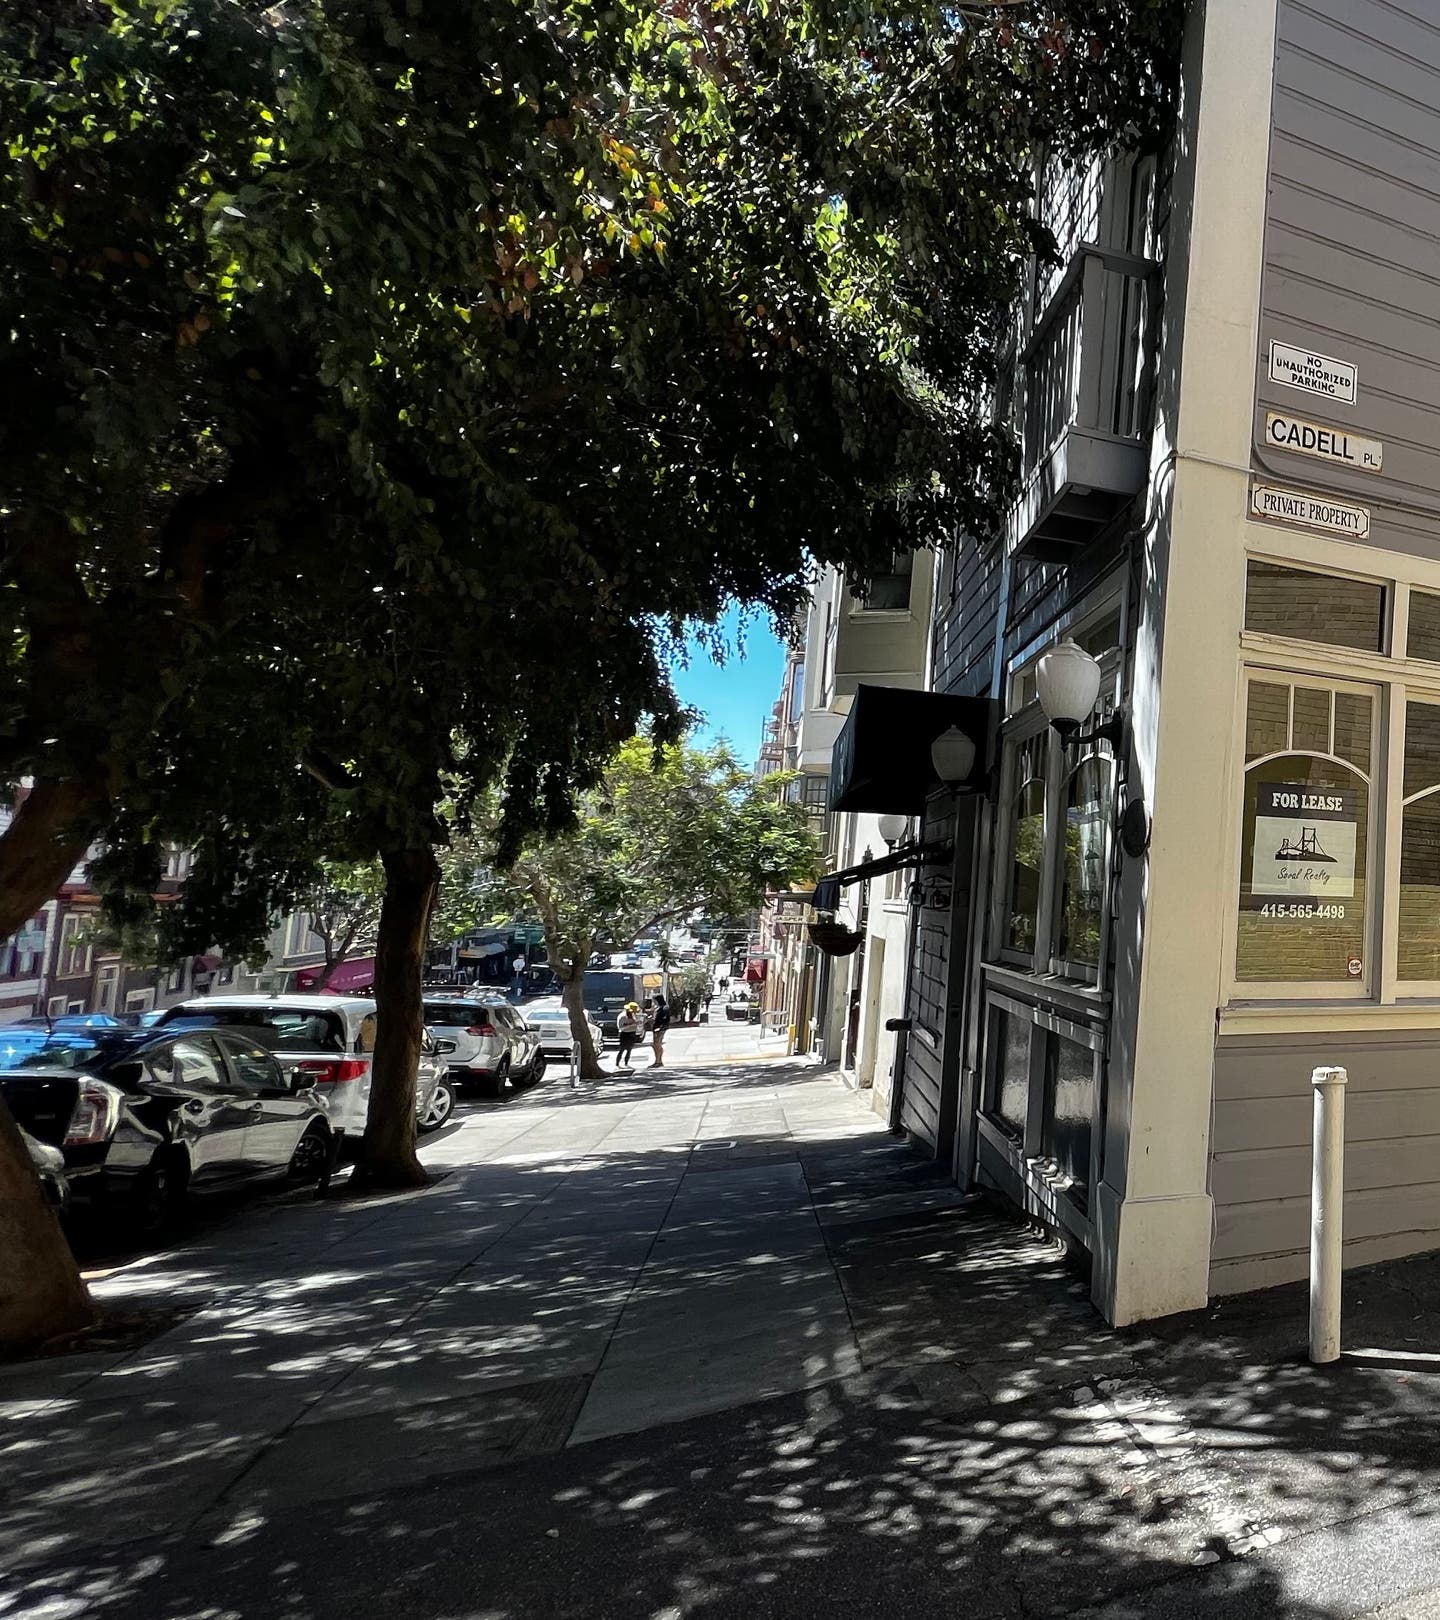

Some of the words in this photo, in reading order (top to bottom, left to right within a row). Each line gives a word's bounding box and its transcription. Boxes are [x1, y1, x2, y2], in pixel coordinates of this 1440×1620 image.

[1307, 356, 1322, 368] NO
[1276, 358, 1351, 387] UNAUTHORIZED
[1292, 373, 1335, 393] PARKING
[1271, 418, 1354, 460] CADELL
[1364, 453, 1378, 467] PL
[1263, 493, 1305, 517] PRIVATE
[1309, 503, 1360, 529] PROPERTY
[1272, 792, 1299, 809] FOR
[1301, 794, 1343, 811] LEASE
[1303, 868, 1331, 885] Realty
[1260, 903, 1345, 919] 415-565-4498
